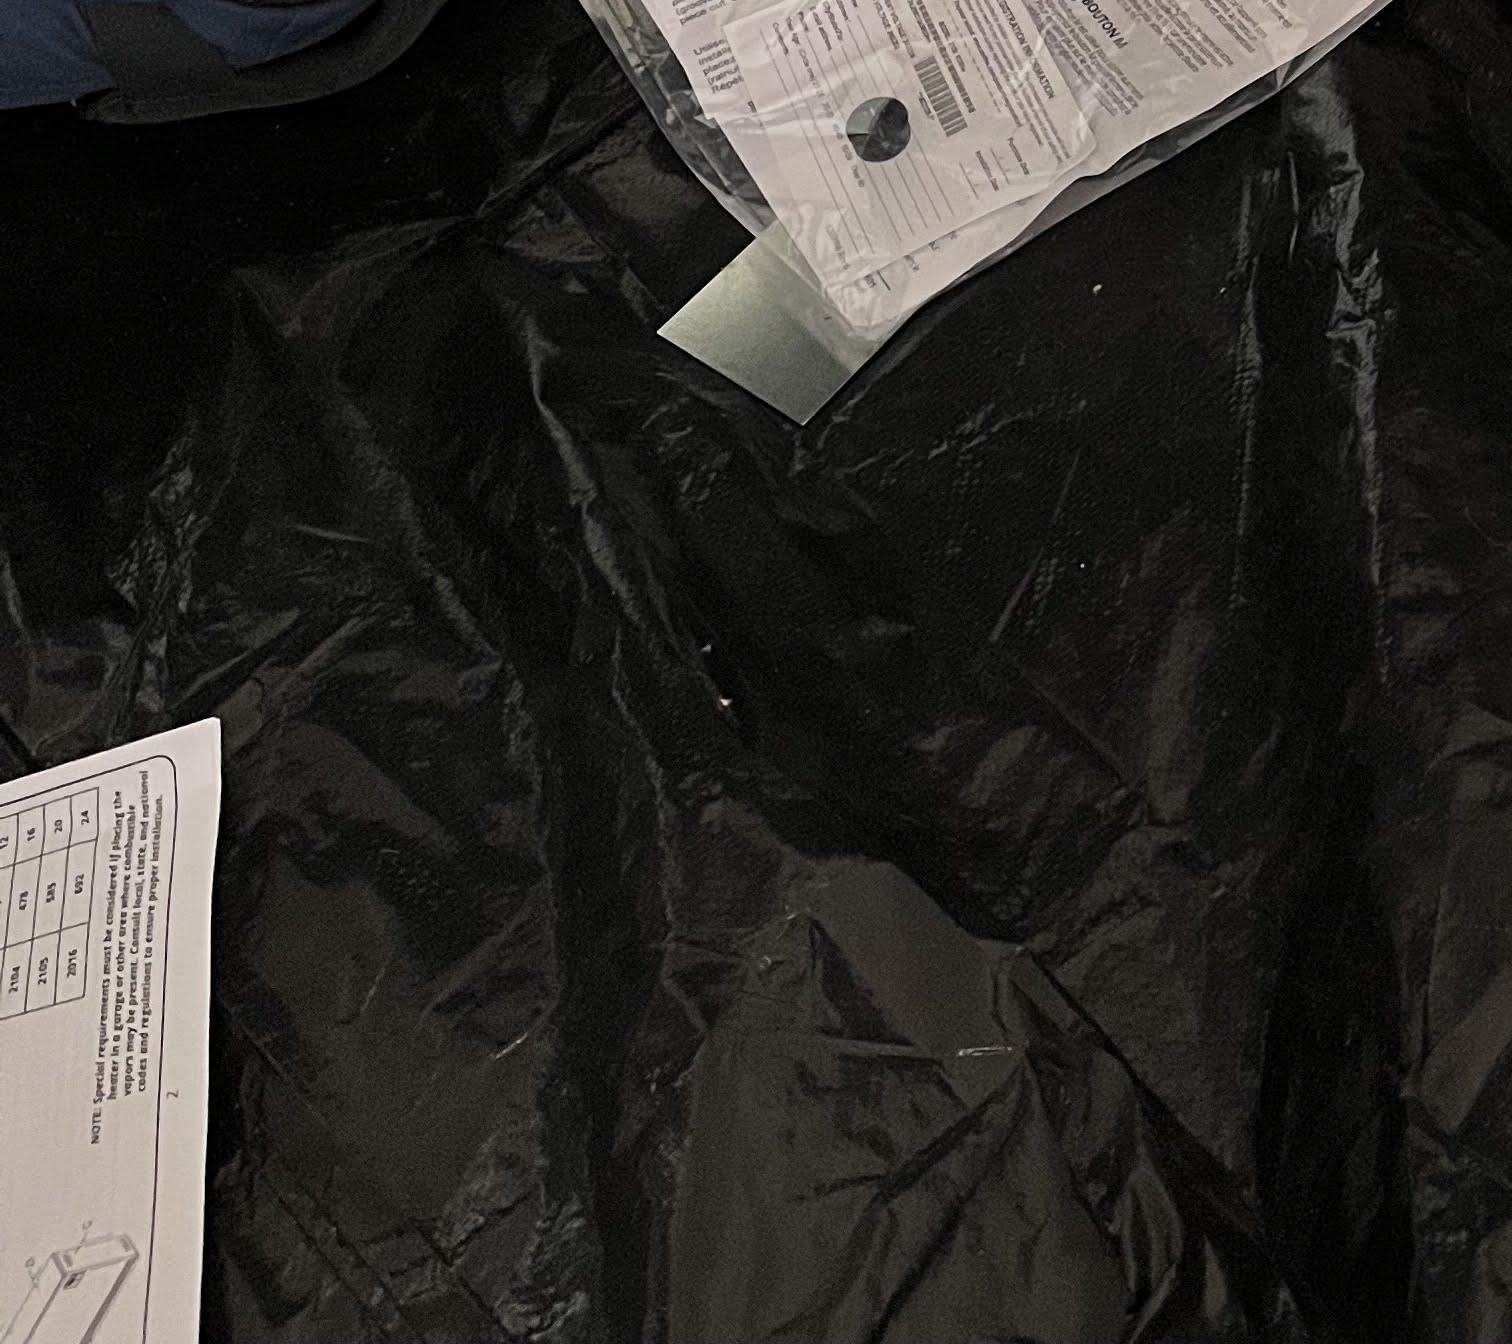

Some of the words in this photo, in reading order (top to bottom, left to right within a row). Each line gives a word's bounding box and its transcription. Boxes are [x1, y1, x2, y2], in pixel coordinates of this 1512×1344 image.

[113, 791, 122, 807] the
[140, 770, 148, 816] national
[110, 812, 121, 849] placing
[122, 805, 135, 869] combustible
[139, 821, 147, 839] and
[150, 795, 162, 860] installation.
[138, 843, 146, 874] state,
[66, 948, 79, 978] 2016
[81, 810, 90, 825] 24
[105, 865, 119, 924] considered
[120, 874, 130, 908] where
[134, 878, 144, 907] local,
[148, 865, 159, 900] proper
[8, 966, 21, 994] 2104
[26, 827, 36, 842] 16
[37, 957, 49, 985] 2105
[54, 819, 64, 834] 20
[104, 929, 114, 941] be
[118, 912, 128, 936] area
[131, 911, 142, 953] Consult
[145, 905, 156, 941] ensure
[102, 946, 113, 974] must
[116, 940, 126, 970] other
[144, 946, 153, 957] to
[115, 975, 124, 986] or
[128, 960, 139, 1004] present.
[140, 962, 152, 1027] regulations
[96, 978, 111, 1056] requirements
[112, 991, 123, 1030] garage
[127, 1010, 136, 1022] be
[110, 1045, 119, 1055] in
[126, 1027, 136, 1051] may
[138, 1032, 147, 1053] and
[93, 1061, 106, 1103] Special
[107, 1060, 118, 1099] heater
[136, 1058, 146, 1091] codes
[167, 1090, 178, 1100] 2
[91, 1108, 101, 1143] NOTE:
